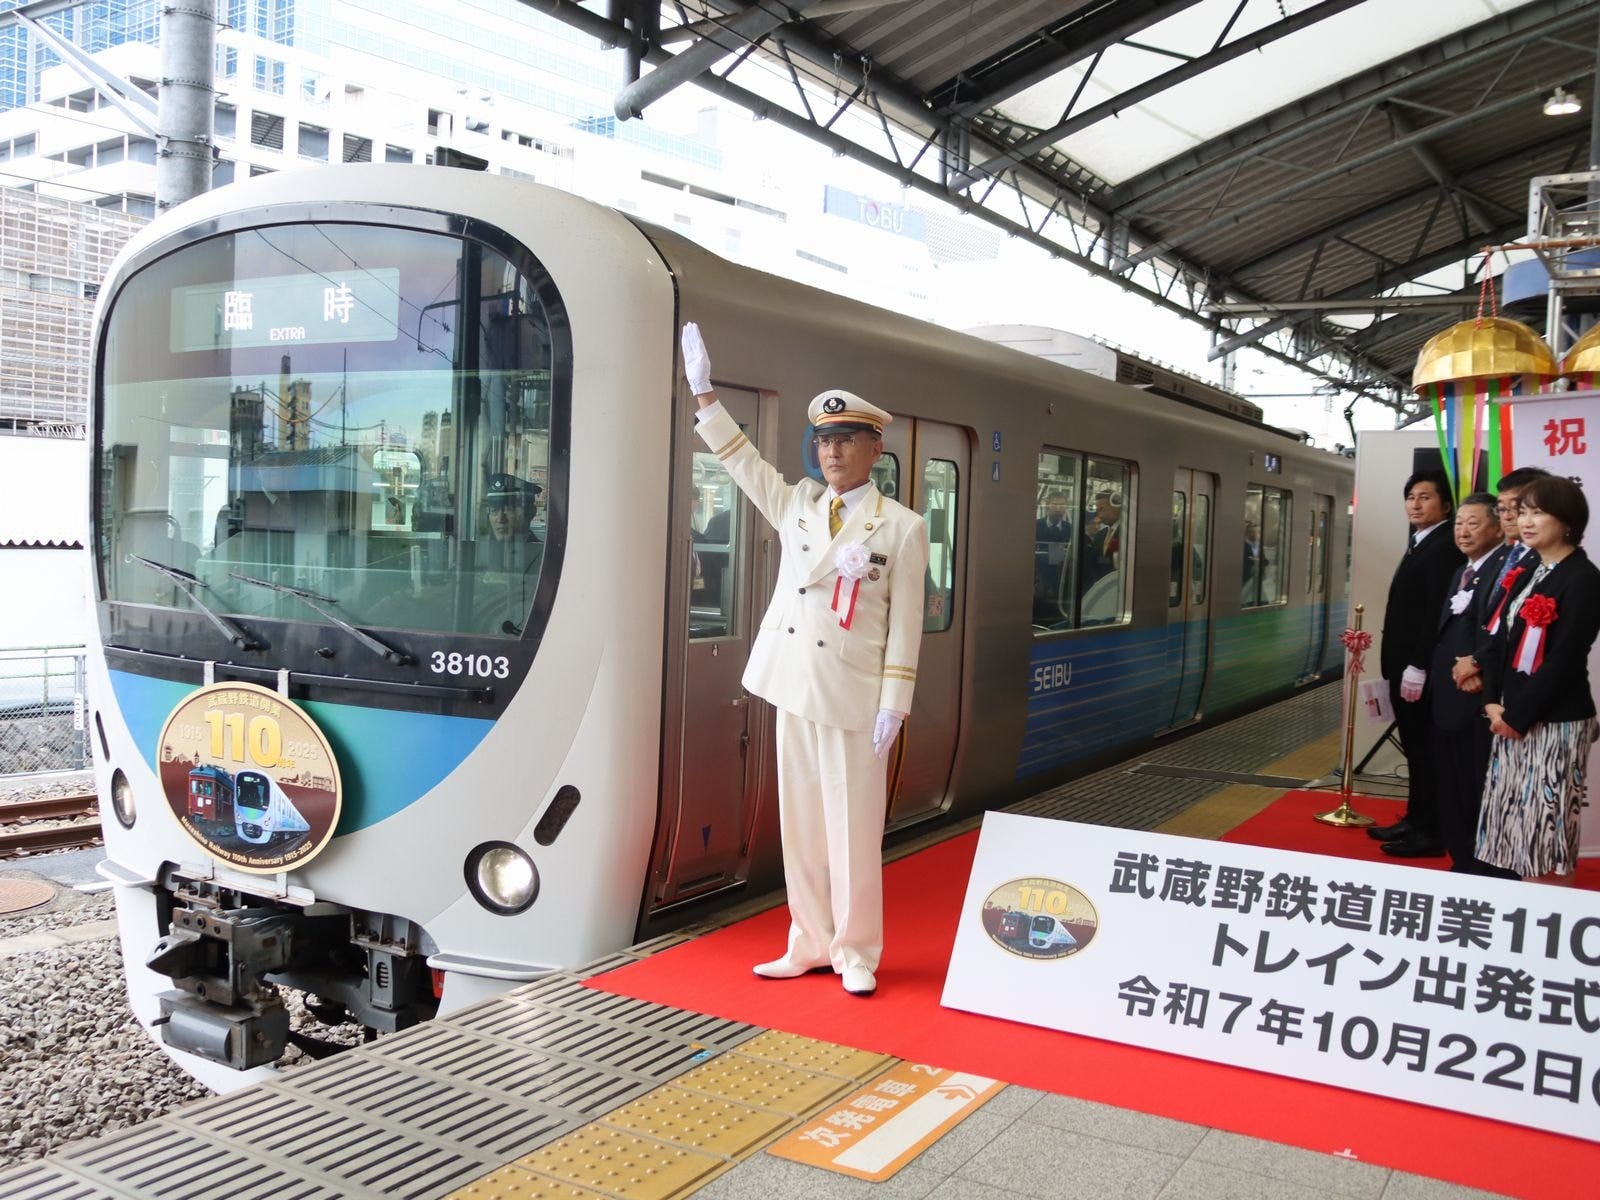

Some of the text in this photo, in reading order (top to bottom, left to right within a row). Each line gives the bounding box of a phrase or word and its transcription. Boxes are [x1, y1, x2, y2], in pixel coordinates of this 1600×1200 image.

[857, 200, 904, 233] TOBU
[270, 327, 305, 341] EXTRA
[1543, 418, 1587, 456] 祝
[430, 651, 509, 679] 38103
[1034, 662, 1072, 692] SEIBU
[208, 841, 231, 858] Railway
[248, 856, 283, 865] Anniversary
[1018, 886, 1067, 915] 110
[1212, 922, 1600, 1034] トレイン出発式
